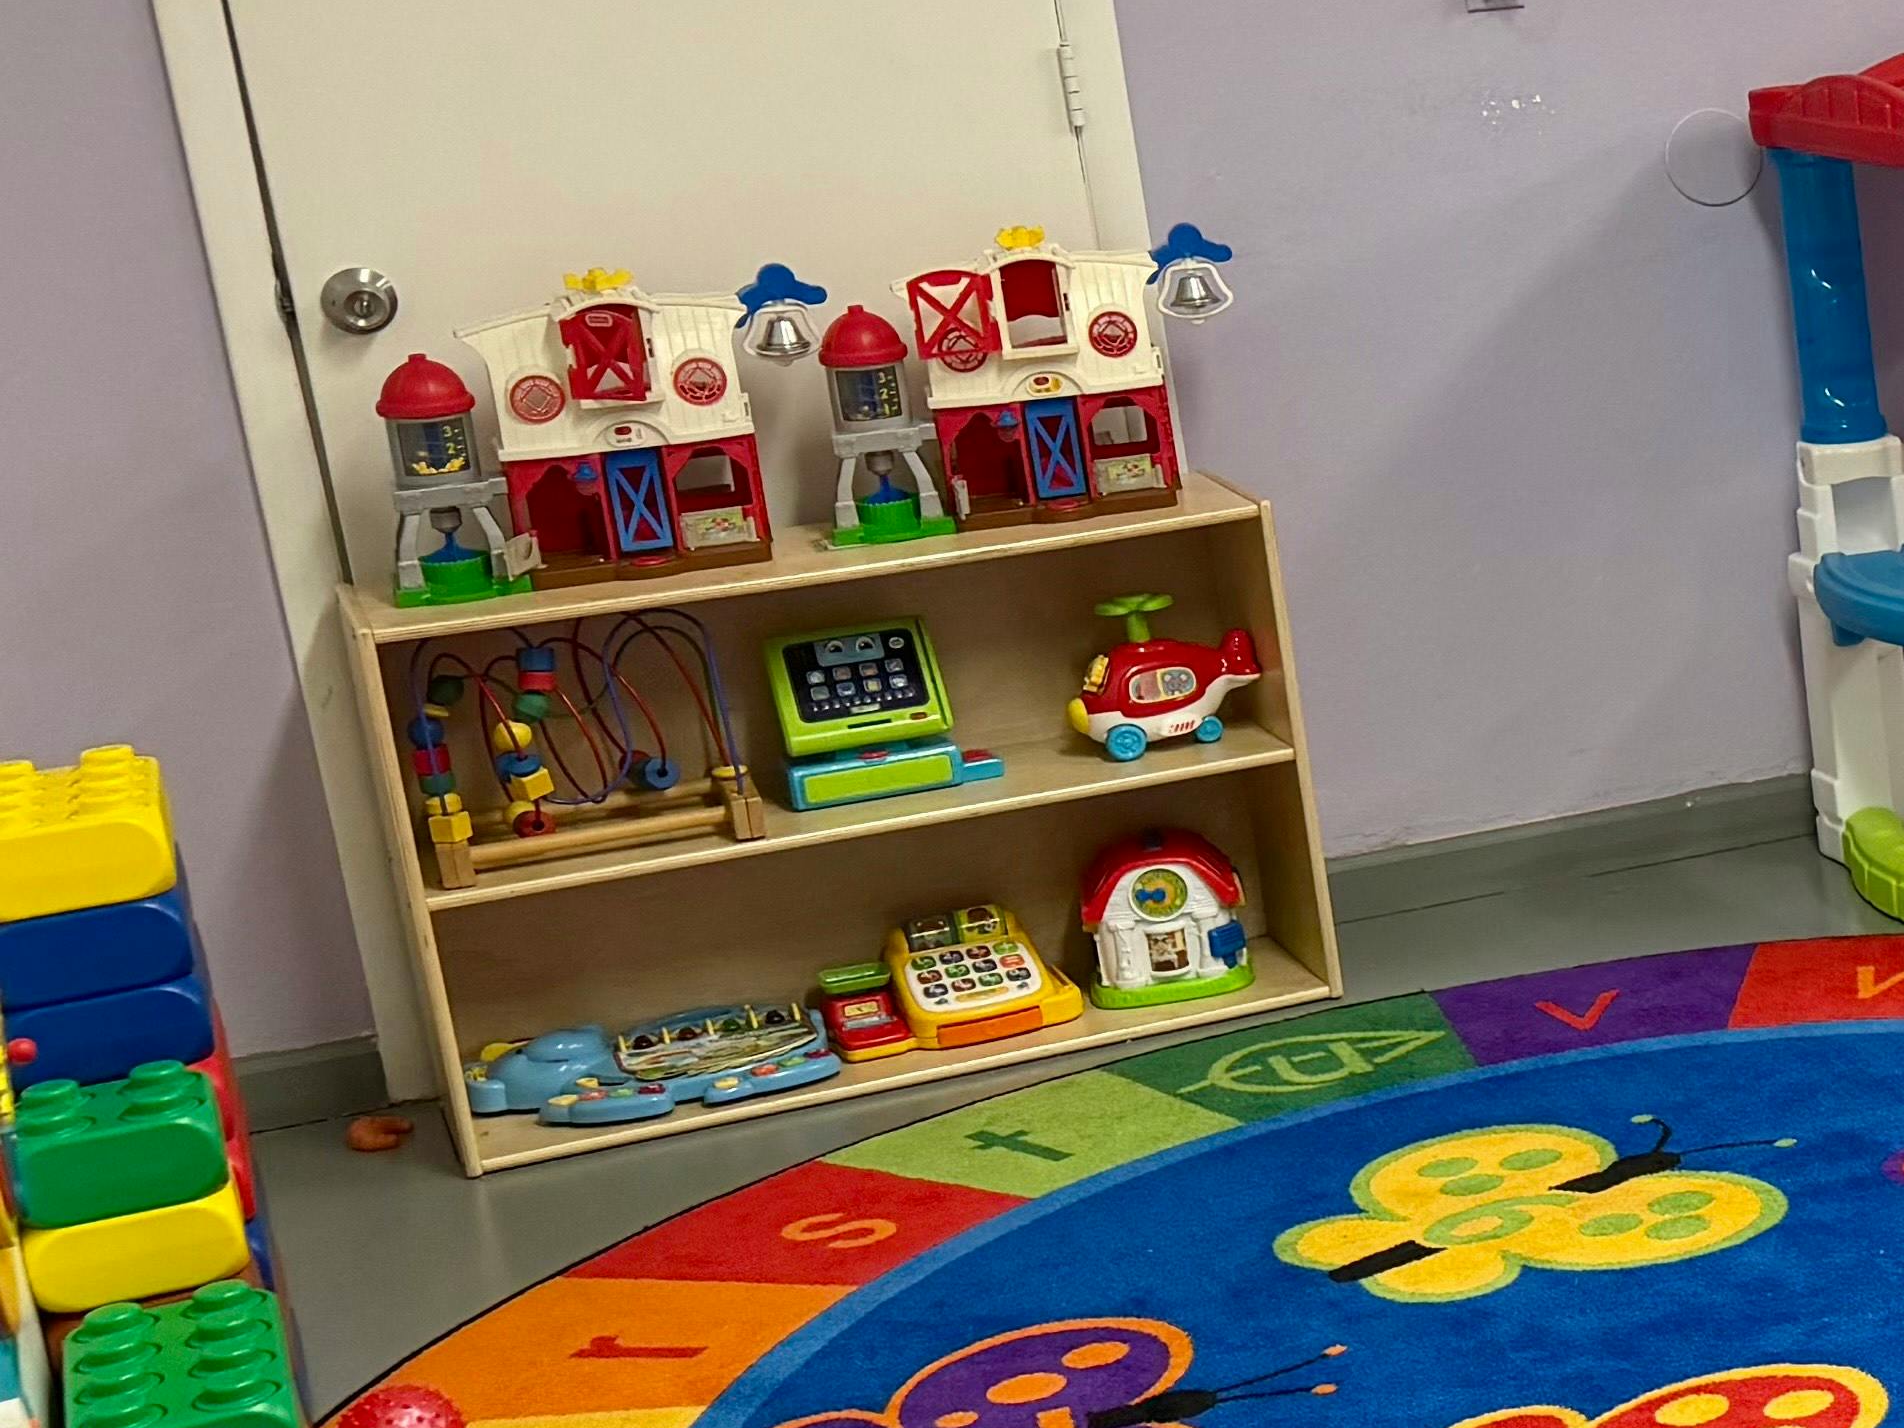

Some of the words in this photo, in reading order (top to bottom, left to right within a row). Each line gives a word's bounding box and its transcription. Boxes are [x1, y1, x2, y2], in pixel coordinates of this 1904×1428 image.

[1536, 989, 1619, 1032] v
[964, 1126, 1072, 1161] t
[779, 1211, 897, 1249] s
[569, 1335, 709, 1364] r
